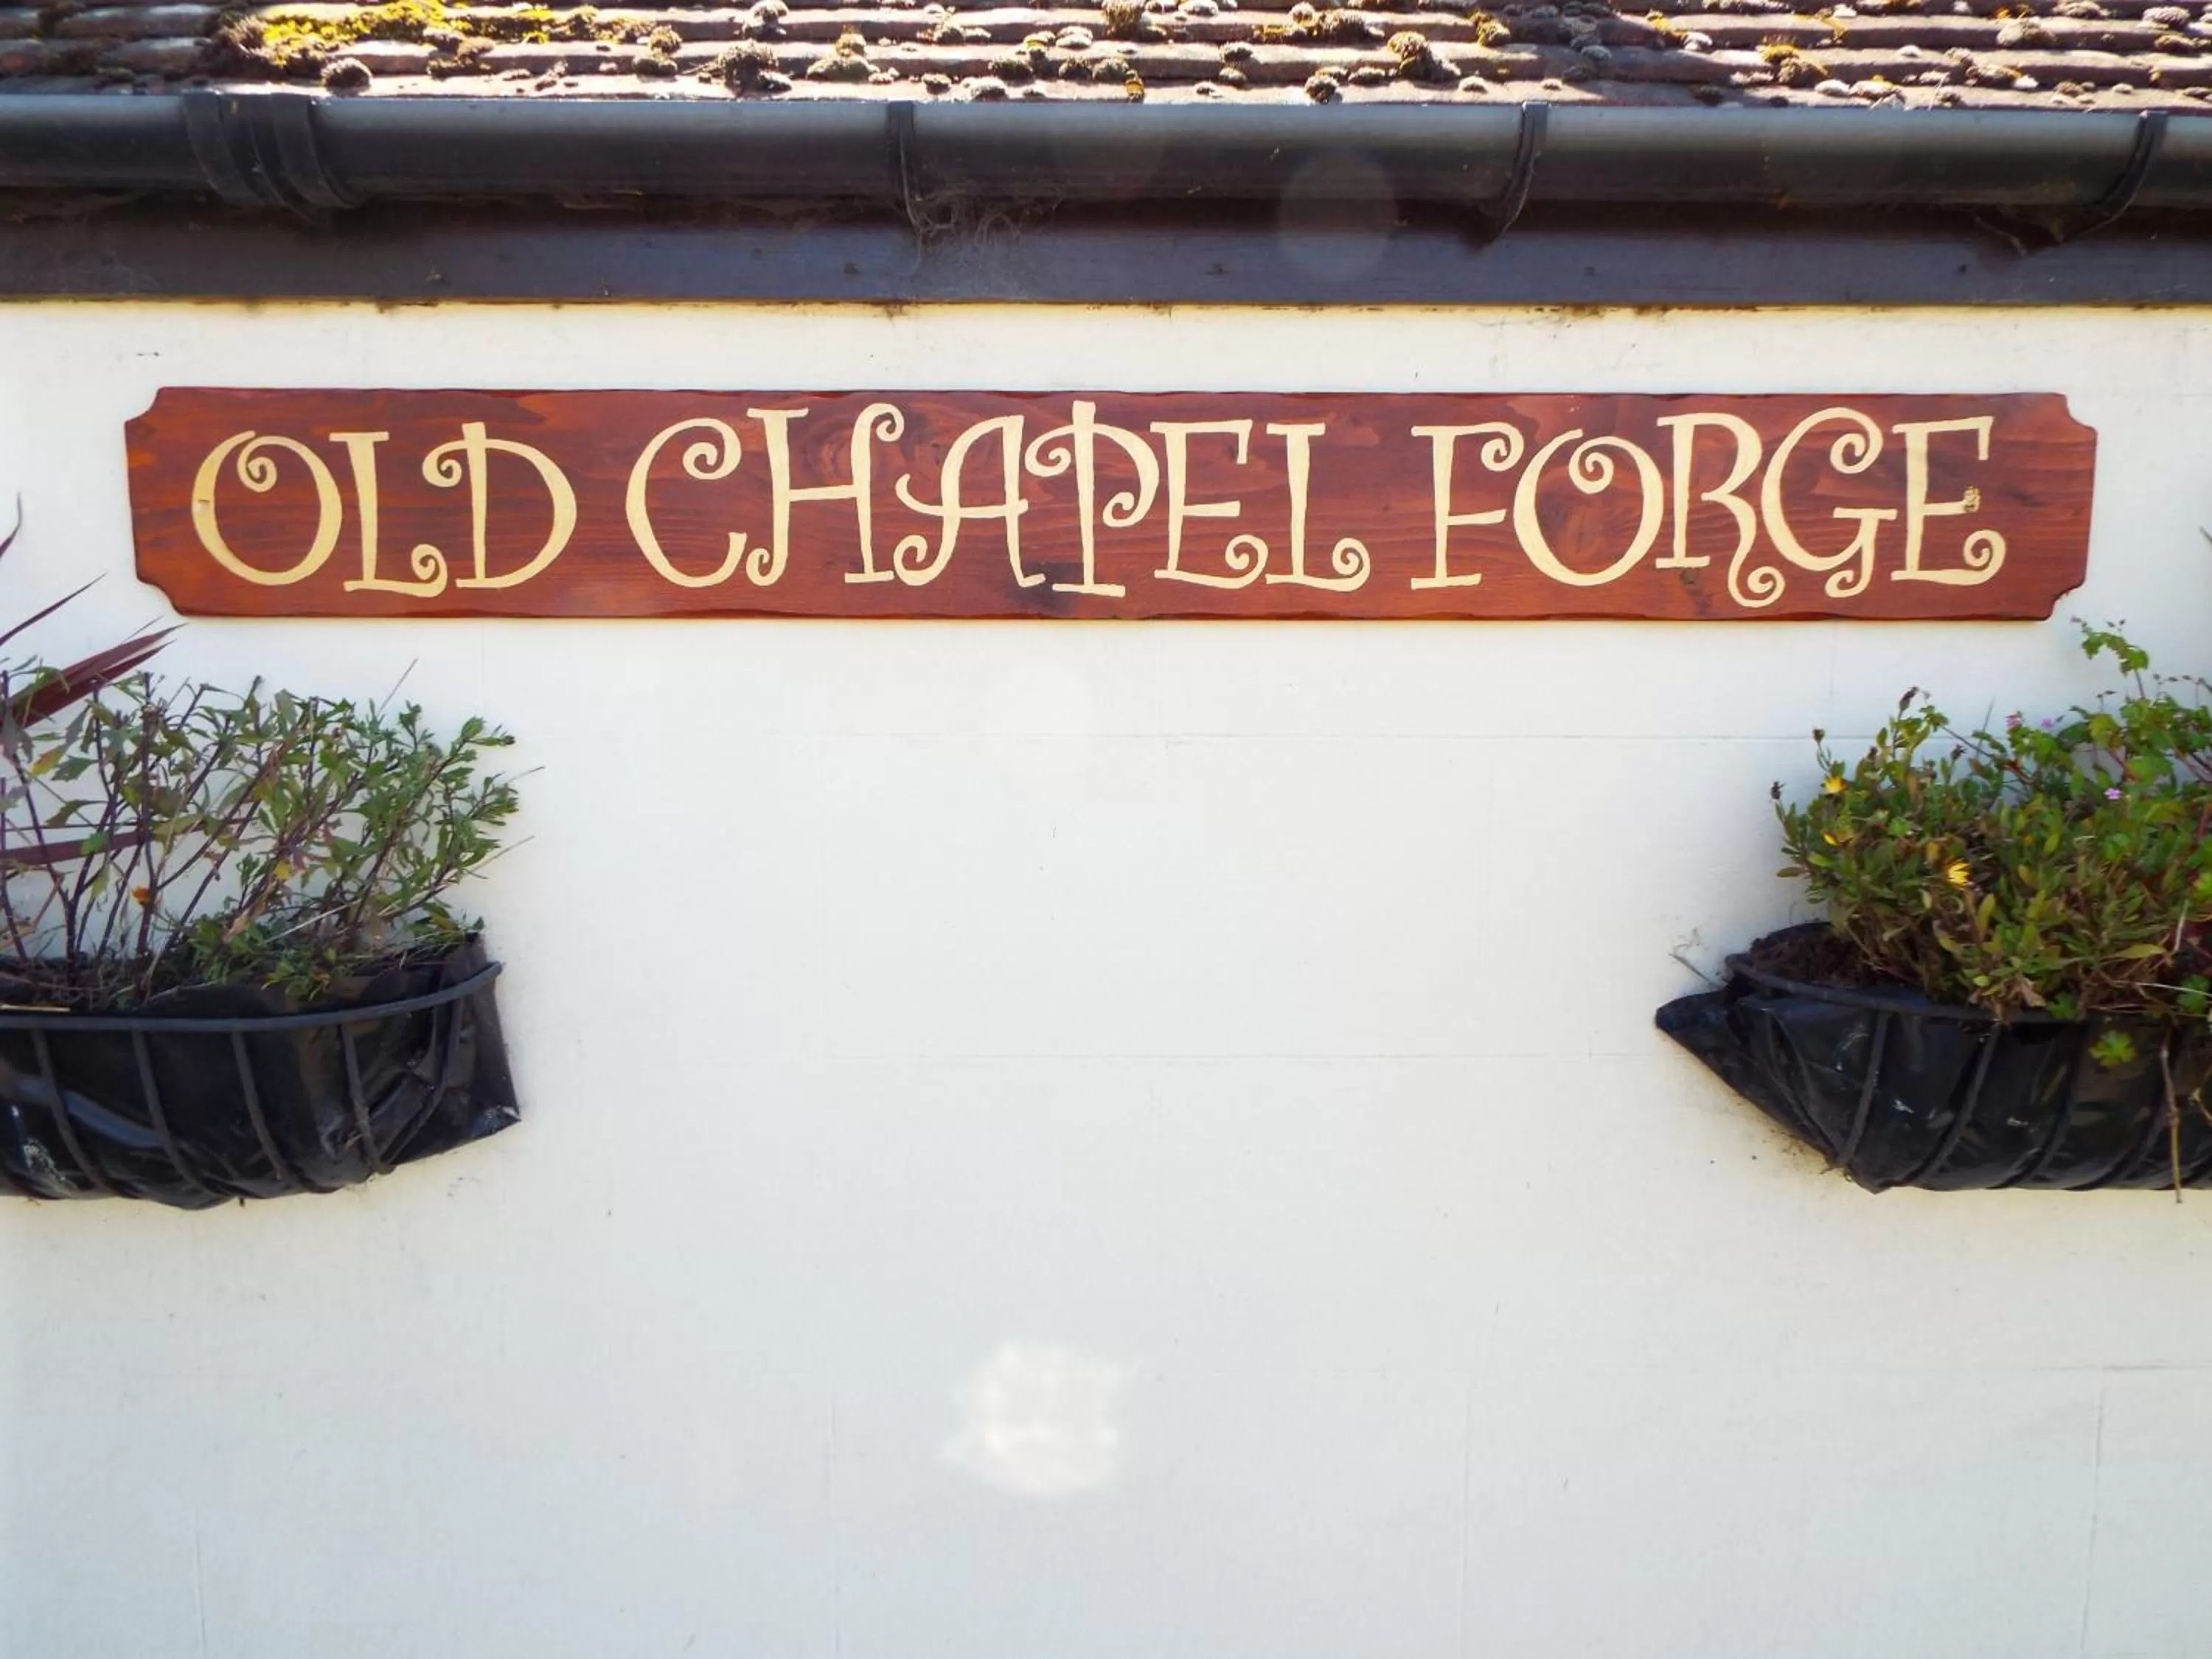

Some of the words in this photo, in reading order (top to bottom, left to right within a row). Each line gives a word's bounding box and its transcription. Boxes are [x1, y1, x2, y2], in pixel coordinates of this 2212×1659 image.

[191, 421, 577, 597] OLD
[625, 400, 1371, 598] CHAPEL
[1410, 406, 2007, 608] FORGE
